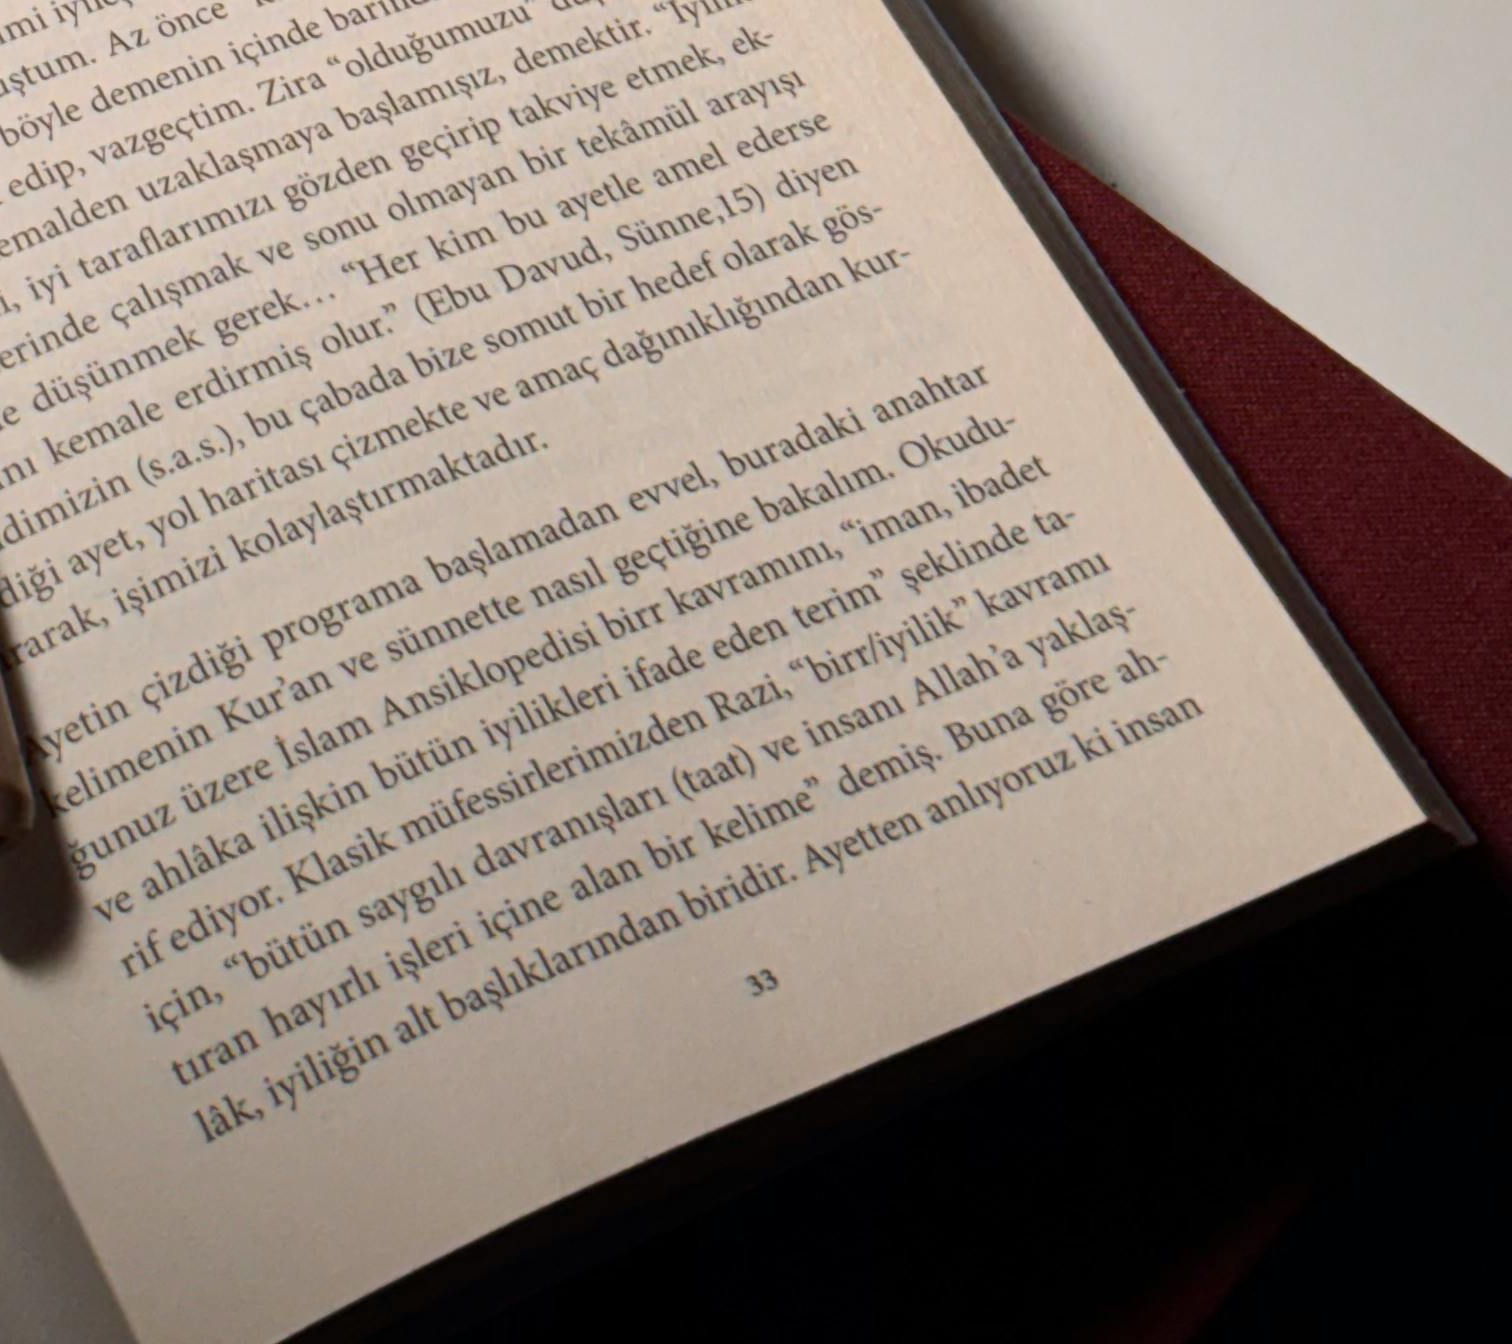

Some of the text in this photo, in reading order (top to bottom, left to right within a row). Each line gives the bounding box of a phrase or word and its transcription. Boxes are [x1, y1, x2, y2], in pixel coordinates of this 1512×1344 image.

[7, 159, 87, 198] edip,
[87, 98, 256, 165] vazgeçtim.
[255, 71, 328, 107] Zira
[109, 27, 151, 57] Az
[154, 2, 229, 38] önce
[135, 121, 335, 202] uzaklaşmaya
[332, 66, 507, 131] başlamışız,
[513, 17, 652, 74] demektir.
[41, 398, 164, 465] kemale
[174, 343, 313, 411] erdirmiş
[413, 282, 492, 325] (Ebu
[492, 234, 613, 294] Davud,
[615, 182, 766, 252] Sünne,15)
[775, 157, 860, 199] diyen
[110, 250, 253, 330] çalışmak
[255, 240, 294, 265] ve
[302, 211, 379, 252] sonu
[387, 165, 519, 222] olmayan
[517, 144, 568, 176] bir
[575, 96, 701, 158] tekâmül
[705, 70, 807, 117] arayışı
[67, 248, 911, 577] ayet, yol haritası çizmekte ve amaç dağınıklığından kur-
[111, 431, 549, 617] işimizi kolaylaştırmaktadır.
[140, 634, 254, 713] çizdiği
[260, 573, 424, 662] programa
[423, 502, 621, 584] başlamadan
[627, 459, 720, 512] evvel,
[717, 406, 867, 478] buradaki
[871, 364, 989, 424] anahtar
[67, 802, 177, 878] ğunuz
[180, 758, 274, 814] üzere
[274, 715, 374, 770] İslam
[383, 619, 602, 728] Ansiklopedisi
[596, 601, 665, 640] birr
[663, 540, 844, 616] kavramını,
[950, 454, 1052, 509] ibadet
[120, 927, 165, 979] rif
[169, 884, 284, 952] ediyor.
[282, 826, 399, 895] Klasik
[398, 709, 709, 845] müfessirlerimizden
[704, 672, 794, 723] Razi,
[972, 552, 1112, 618] kavramı
[143, 984, 224, 1034] için,
[357, 859, 468, 929] saygılı
[472, 785, 670, 877] davranışları
[671, 743, 757, 802] (taat)
[759, 734, 801, 763] ve
[801, 694, 907, 748] insanı
[1024, 605, 1136, 669] yaklaş-
[171, 1028, 261, 1087] tıran
[260, 963, 382, 1039] hayırlı
[384, 919, 475, 983] işleri
[475, 889, 563, 942] içine
[569, 858, 644, 902] alan
[641, 834, 698, 870] bir
[837, 742, 944, 797] demiş.
[942, 704, 1036, 753] Buna
[1040, 673, 1110, 725] göre
[1115, 647, 1168, 685] ah-
[192, 697, 1205, 1144] lâk, iyiliğin alt başlıklarından biridir. Ayetten anlıyoruz ki insan
[745, 968, 779, 997] 33
